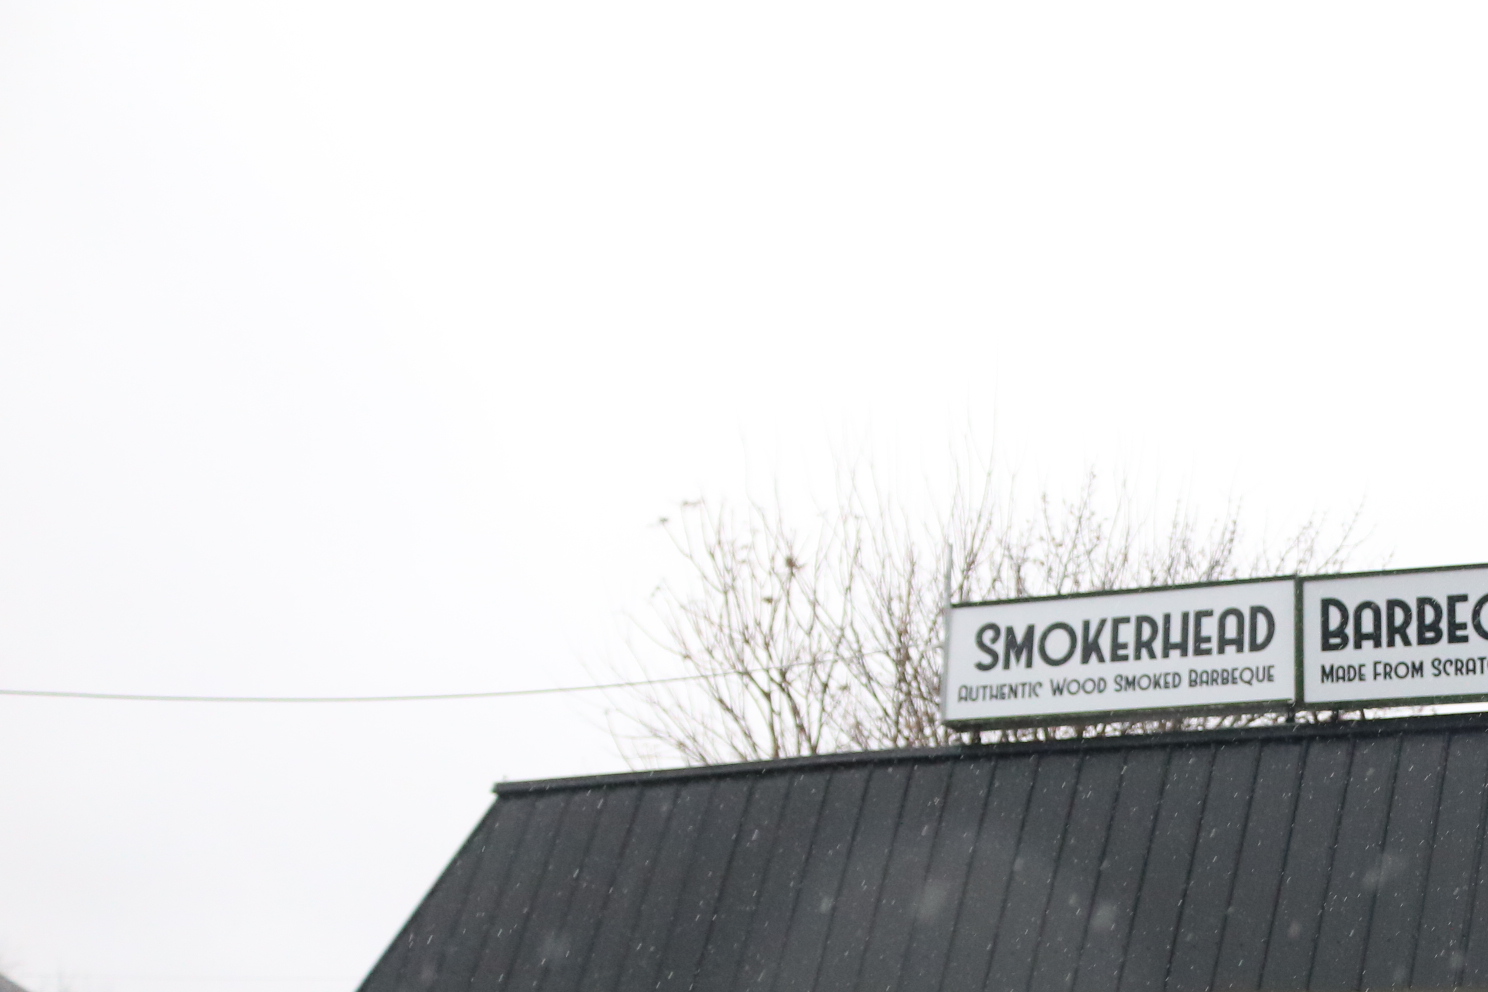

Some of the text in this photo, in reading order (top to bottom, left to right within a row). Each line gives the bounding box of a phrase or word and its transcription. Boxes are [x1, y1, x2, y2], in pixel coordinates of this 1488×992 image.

[975, 605, 1275, 672] SMOKERHEAD
[958, 664, 1276, 703] AUTHENTIC WOOD SMOKED BARBEQUE
[1320, 662, 1366, 683] MADE
[1372, 659, 1424, 681] FROM
